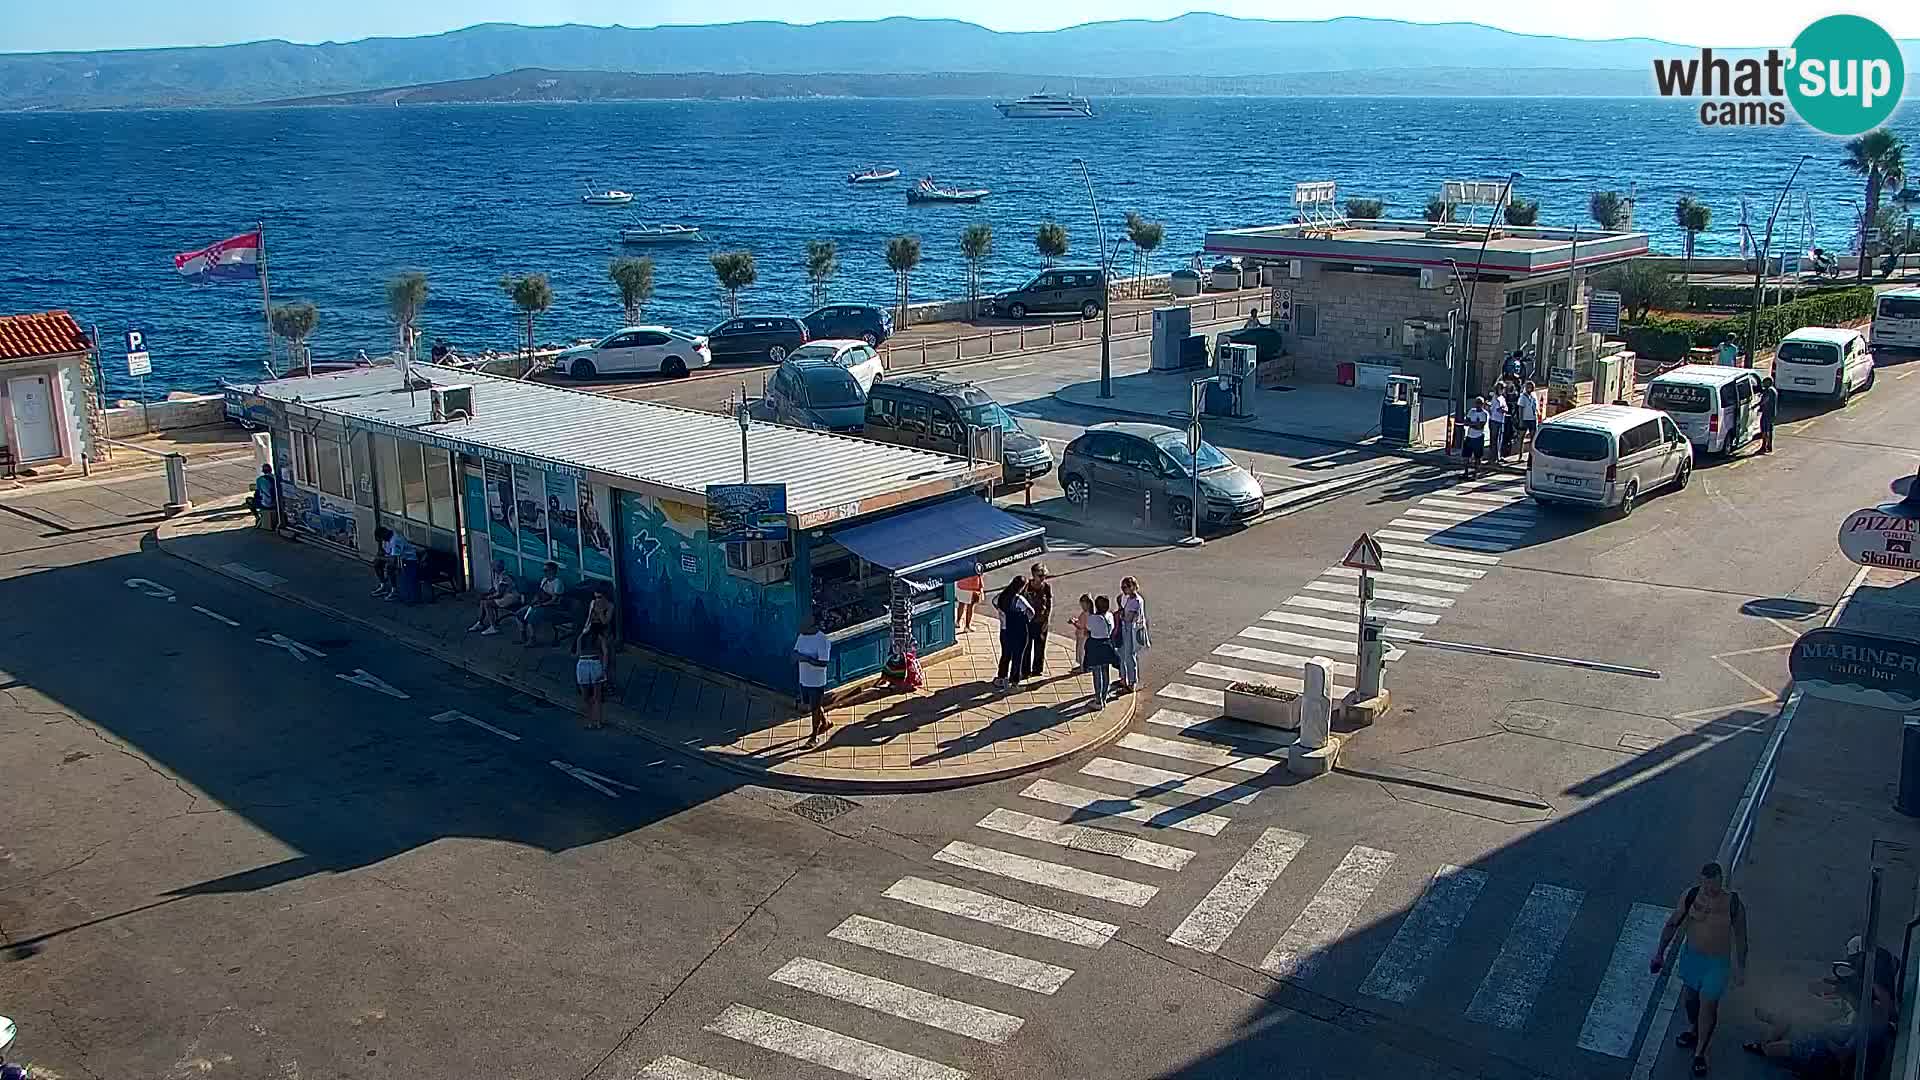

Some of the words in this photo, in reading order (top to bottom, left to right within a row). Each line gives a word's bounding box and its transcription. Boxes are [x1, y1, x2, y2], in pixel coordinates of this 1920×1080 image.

[128, 331, 143, 350] P
[1664, 386, 1698, 396] TAXI
[436, 440, 468, 454] POSTAJA
[478, 446, 494, 458] BUS
[494, 449, 526, 466] STATION
[528, 458, 554, 473] TICKET
[554, 464, 584, 479] OFFICE
[1848, 516, 1920, 534] PIZZE
[1801, 643, 1920, 674] MARINER
[1871, 666, 1897, 681] bar
